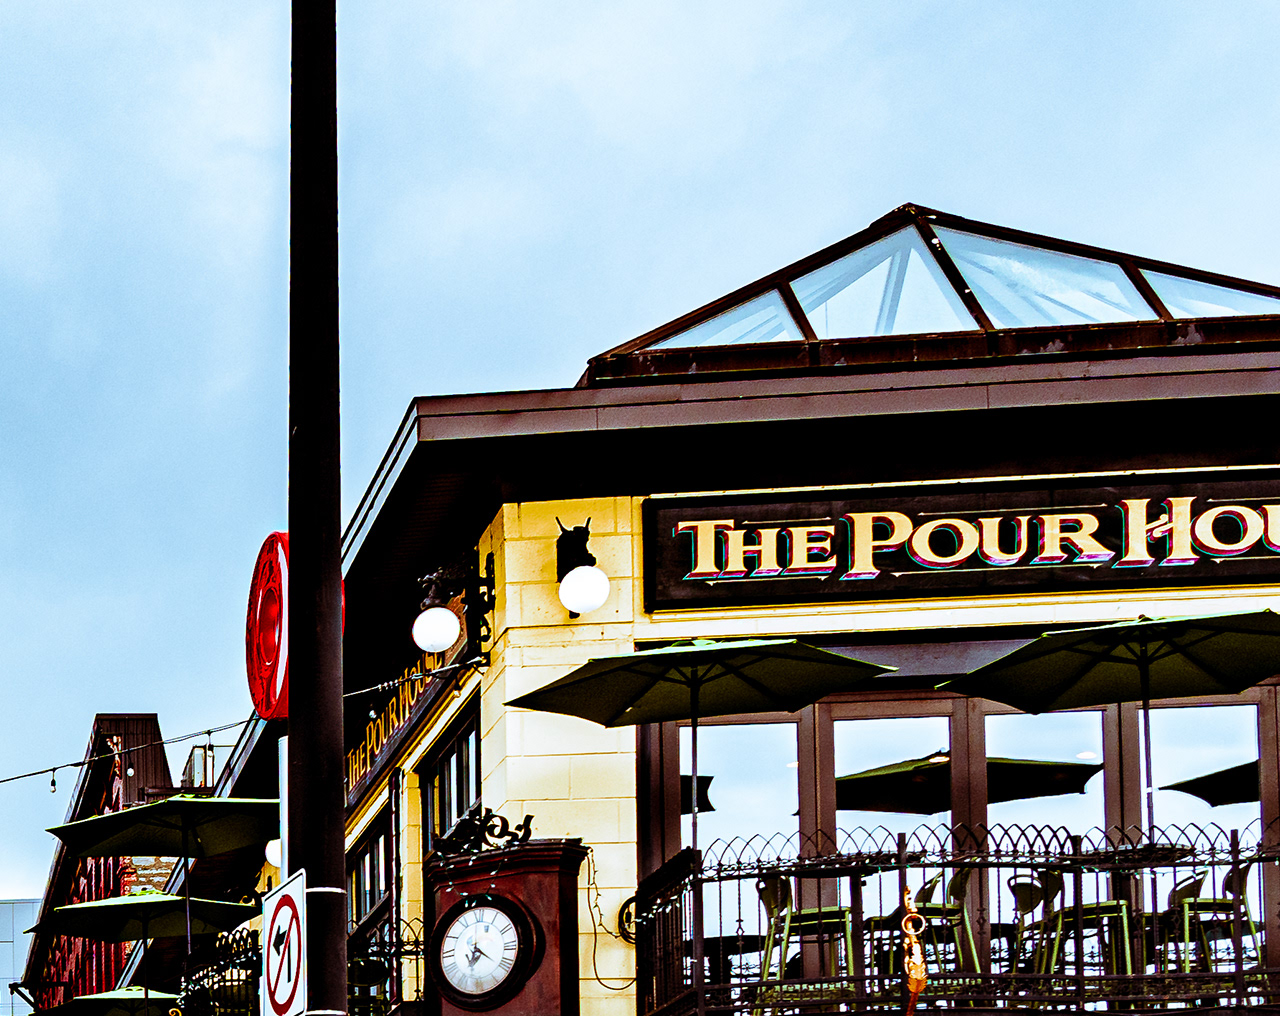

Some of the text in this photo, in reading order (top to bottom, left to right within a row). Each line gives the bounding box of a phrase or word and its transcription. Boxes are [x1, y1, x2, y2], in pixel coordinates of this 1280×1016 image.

[673, 518, 836, 580] THE
[840, 511, 1115, 580] POUR
[347, 741, 366, 792] THE
[366, 696, 399, 774] POUR
